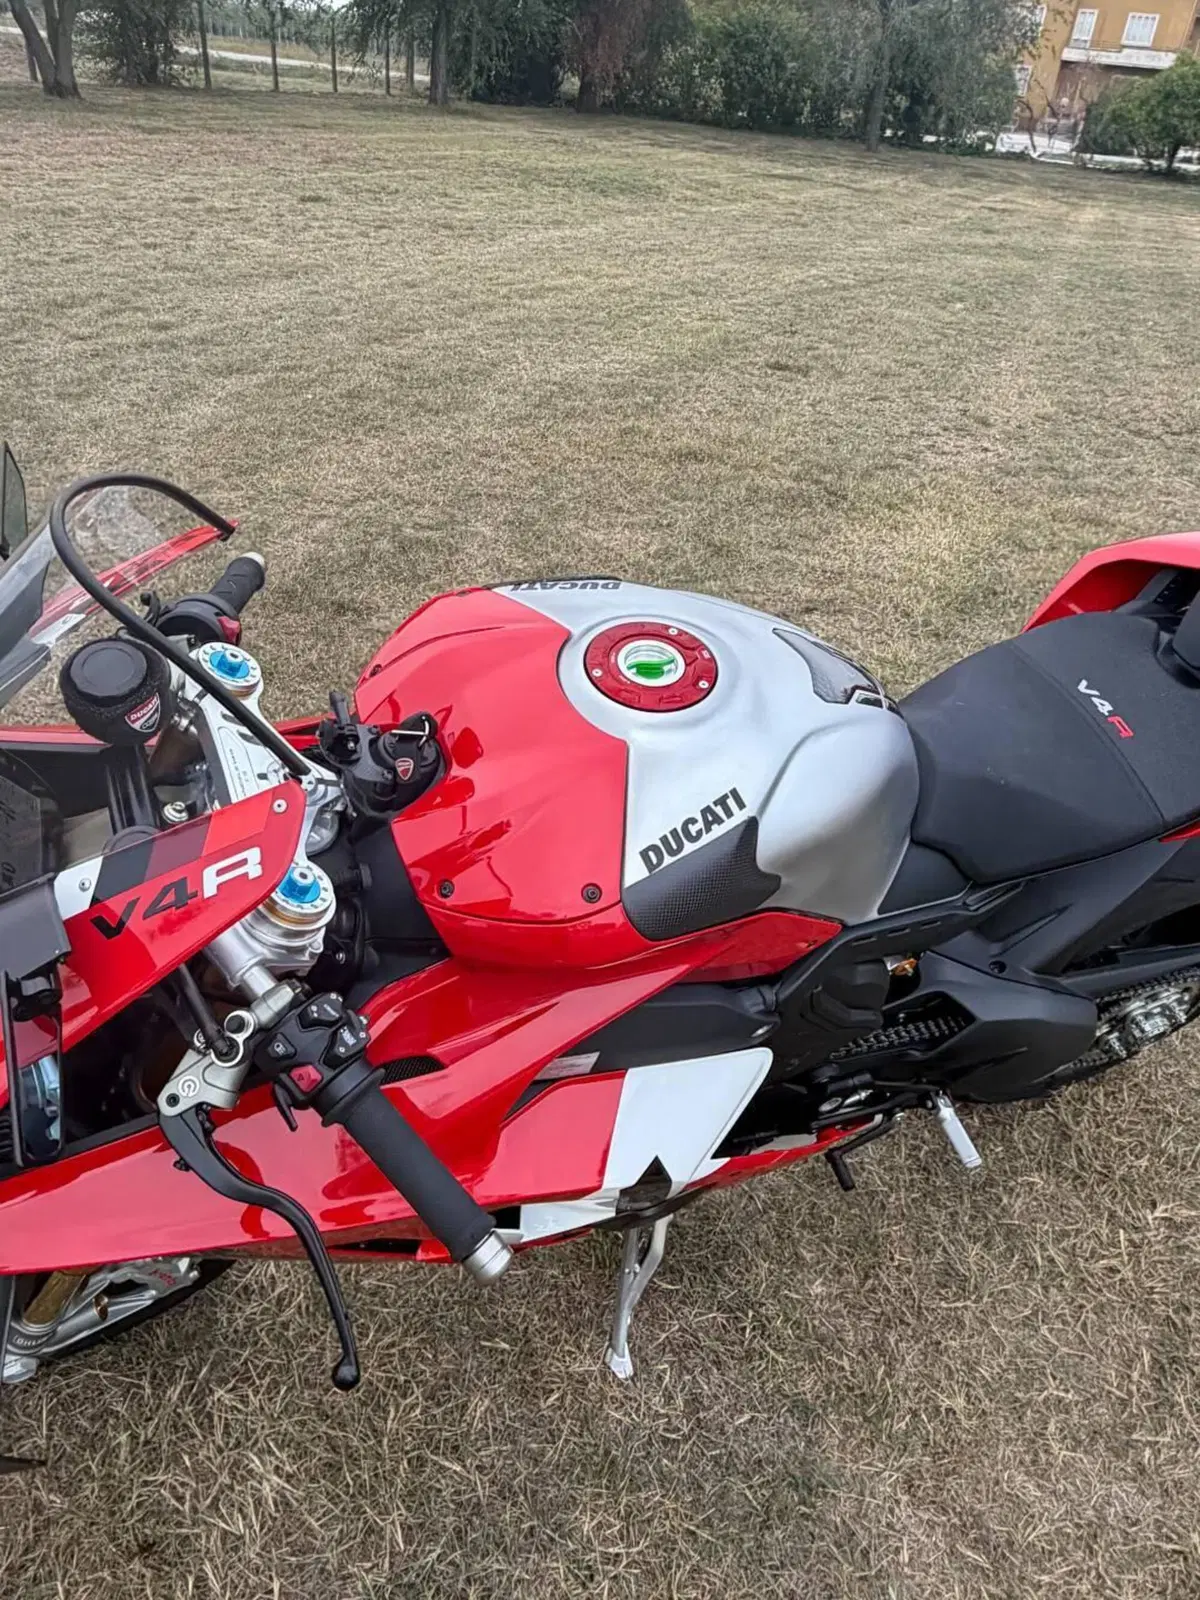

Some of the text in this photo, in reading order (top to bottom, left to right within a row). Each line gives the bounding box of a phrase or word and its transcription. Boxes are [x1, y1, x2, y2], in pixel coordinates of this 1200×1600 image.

[510, 580, 621, 592] DUCATI
[1077, 679, 1134, 738] V4R
[638, 786, 747, 875] DUCATI
[90, 846, 263, 940] V4R
